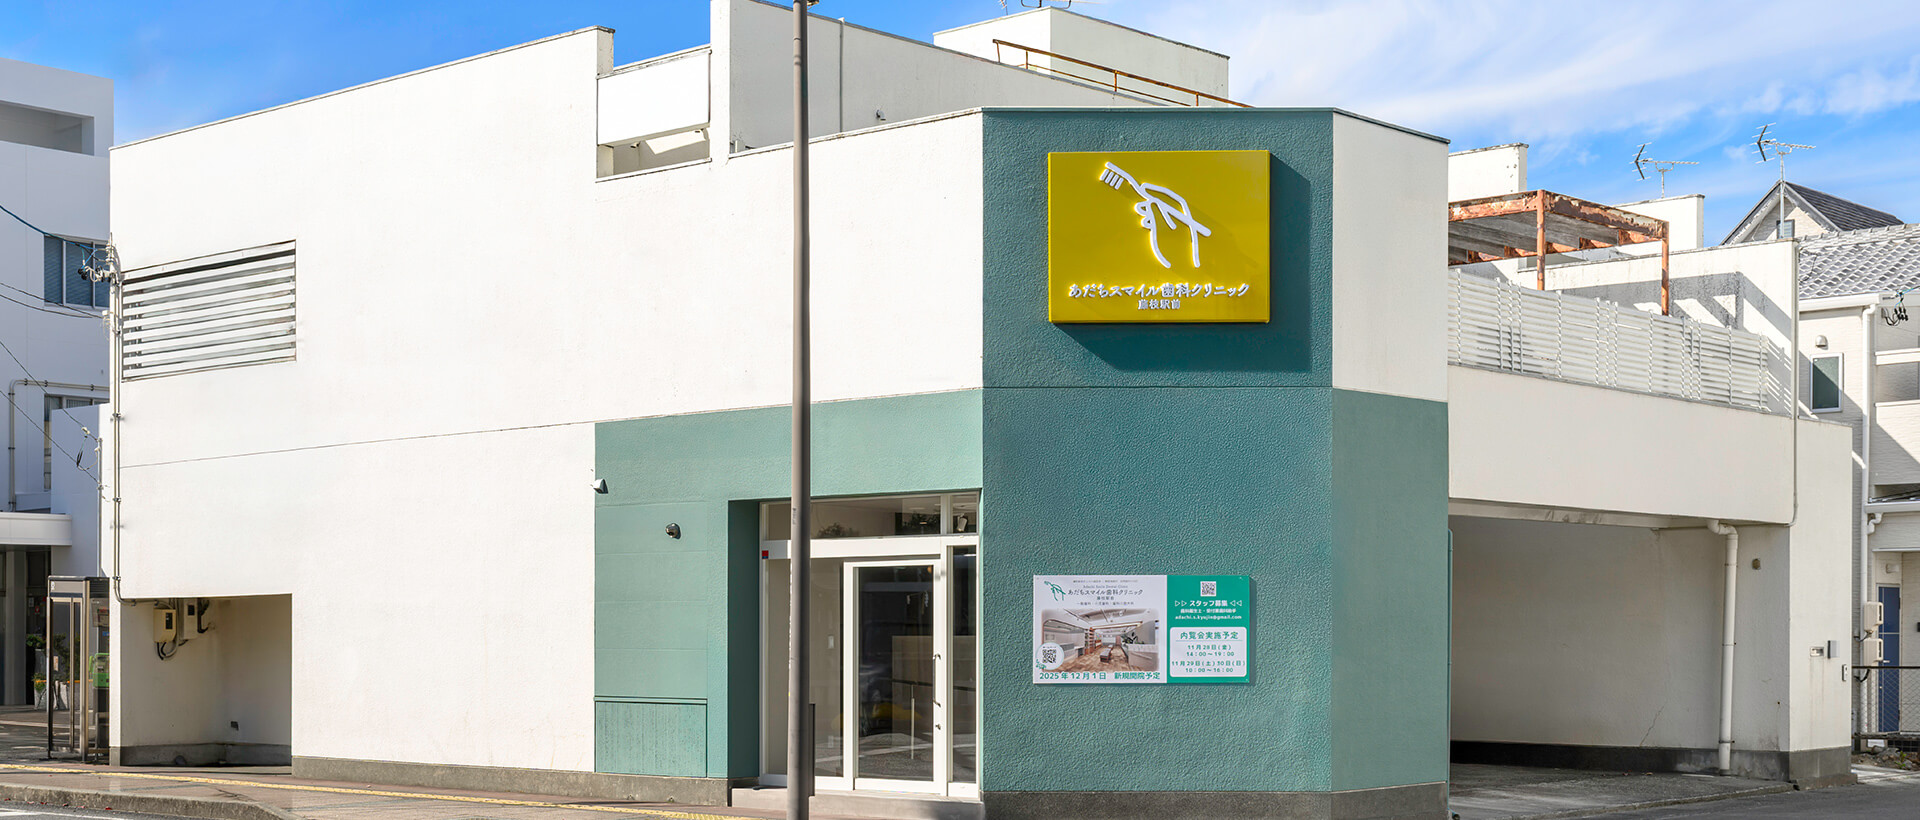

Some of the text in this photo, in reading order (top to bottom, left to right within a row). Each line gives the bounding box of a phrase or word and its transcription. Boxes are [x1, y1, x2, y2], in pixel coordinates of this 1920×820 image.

[1068, 282, 1250, 299] あだちスマイル歯科クリニック
[1138, 299, 1181, 310] 藤枝駅前
[1180, 631, 1239, 640] 内覧会実施予定
[1114, 672, 1161, 680] 新規開院予定
